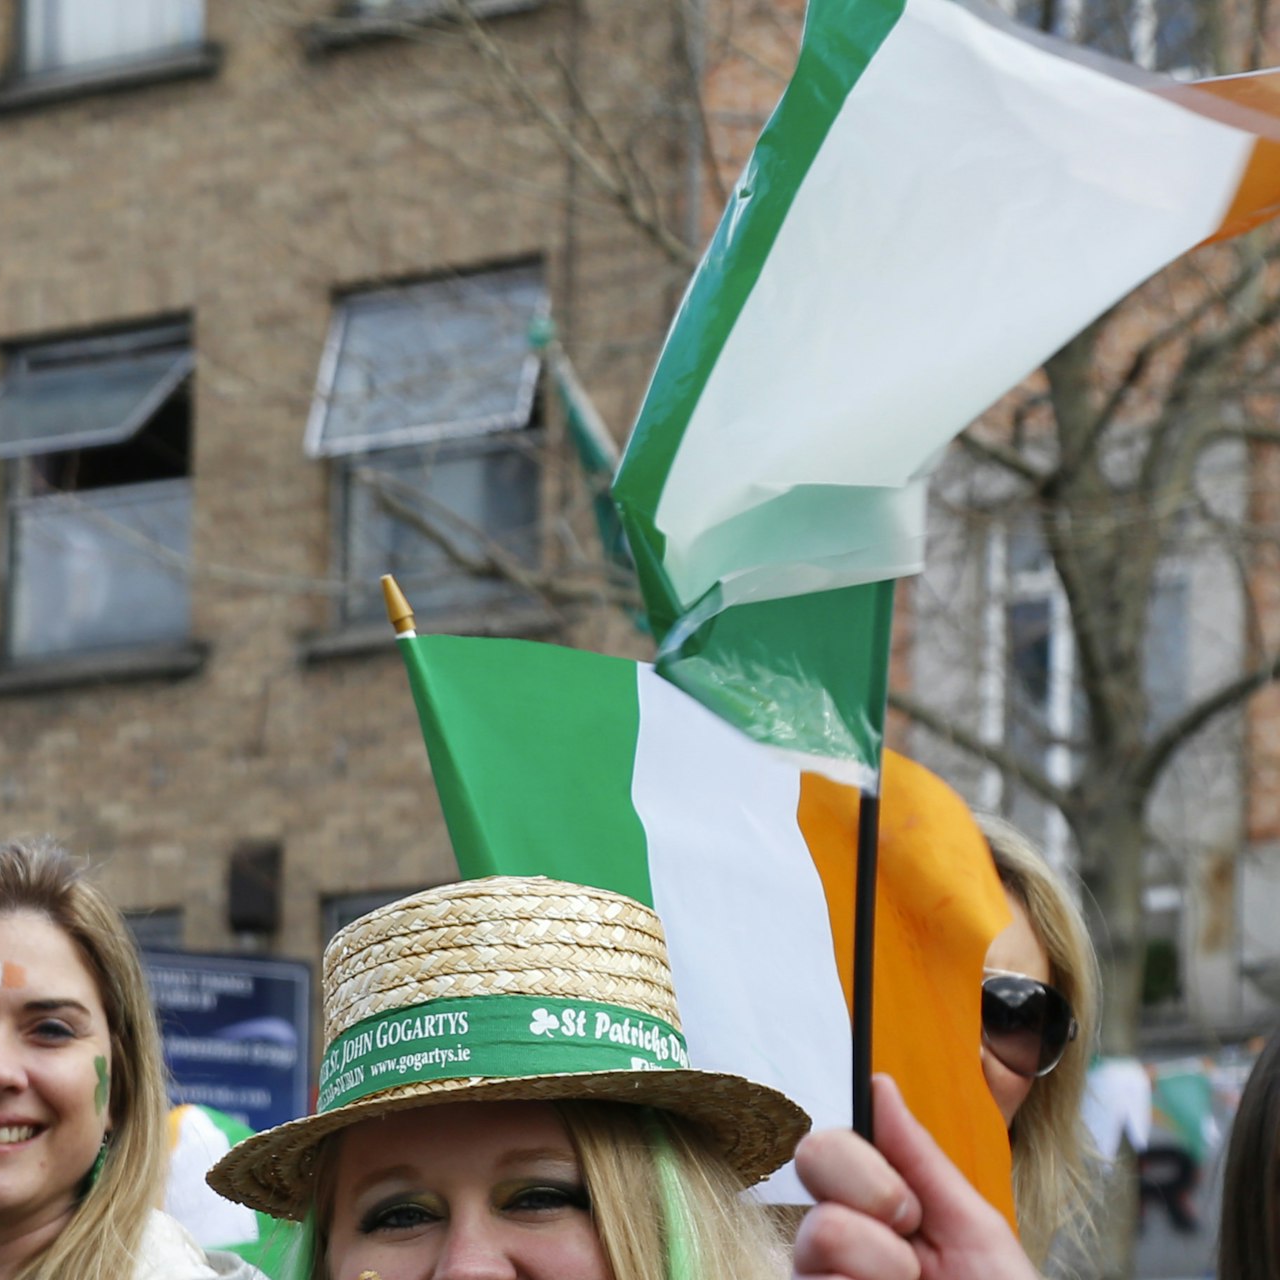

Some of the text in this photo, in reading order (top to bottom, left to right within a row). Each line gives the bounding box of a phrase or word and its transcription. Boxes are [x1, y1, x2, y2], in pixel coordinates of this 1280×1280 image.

[341, 1030, 374, 1073] JOHN
[375, 1010, 470, 1050] GOGARTYS
[370, 1043, 471, 1077] www.gogartys.ie
[560, 1008, 690, 1069] St Patricks Da
